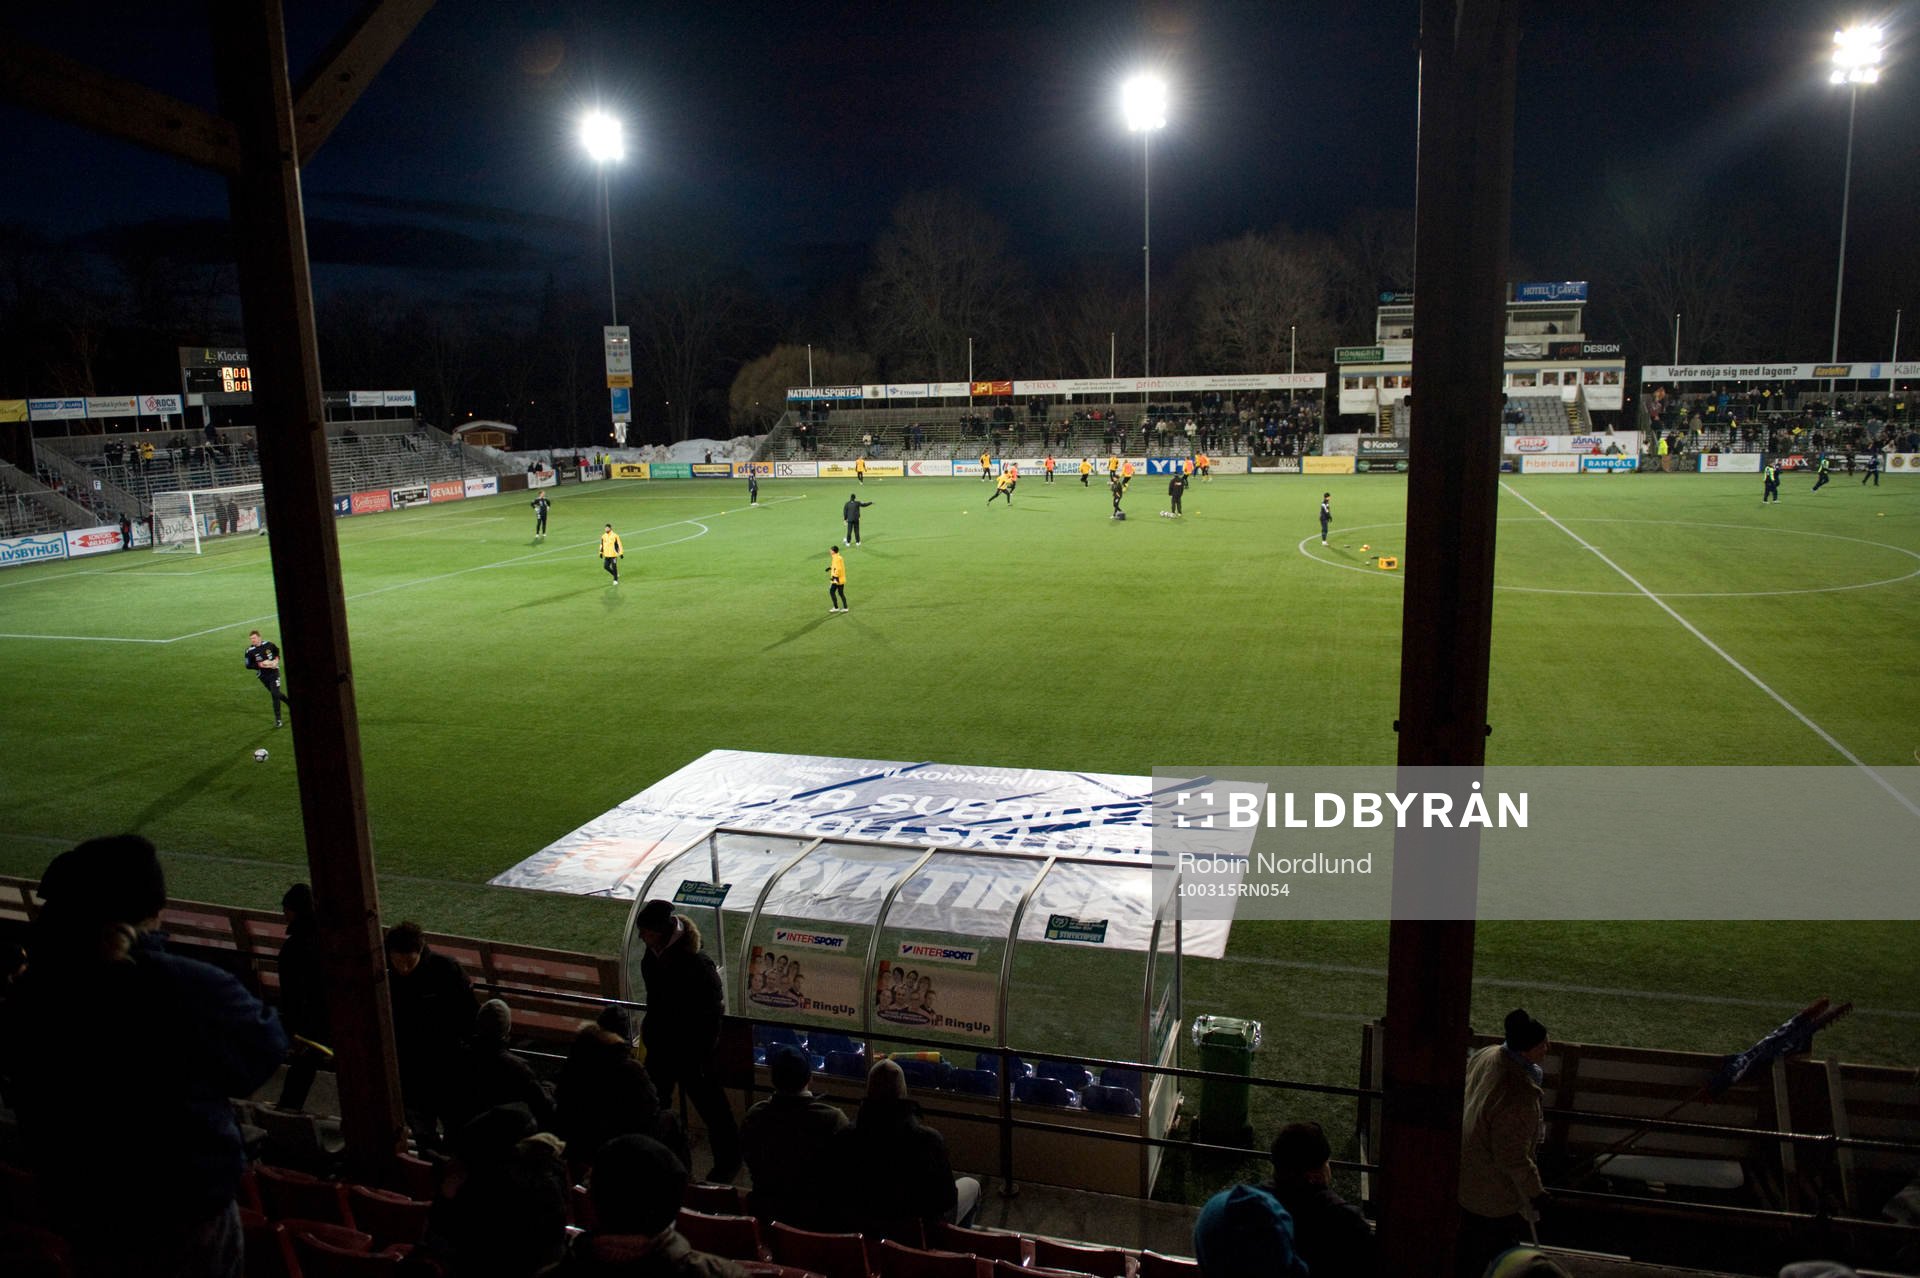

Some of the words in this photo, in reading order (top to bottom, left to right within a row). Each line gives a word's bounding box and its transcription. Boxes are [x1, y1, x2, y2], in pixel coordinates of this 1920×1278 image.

[1523, 286, 1549, 296] HOTELL
[1583, 344, 1620, 354] DESIGN
[1668, 368, 1698, 377] Varför
[1700, 367, 1721, 378] nöja
[1723, 367, 1737, 378] sig
[1739, 366, 1760, 376] med
[1762, 365, 1798, 378] lagom?
[386, 393, 413, 402] SKANSKA
[787, 387, 862, 399] NATIONALSPORTEN
[156, 399, 177, 408] ROCK
[737, 462, 769, 475] office
[430, 485, 464, 498] GEVALIA
[0, 543, 60, 561] LVSBYHUS
[786, 932, 844, 947] INTERSPORT
[912, 945, 975, 961] INTERSPORT
[812, 1000, 856, 1016] RingUp
[945, 1017, 991, 1033] RingUp
